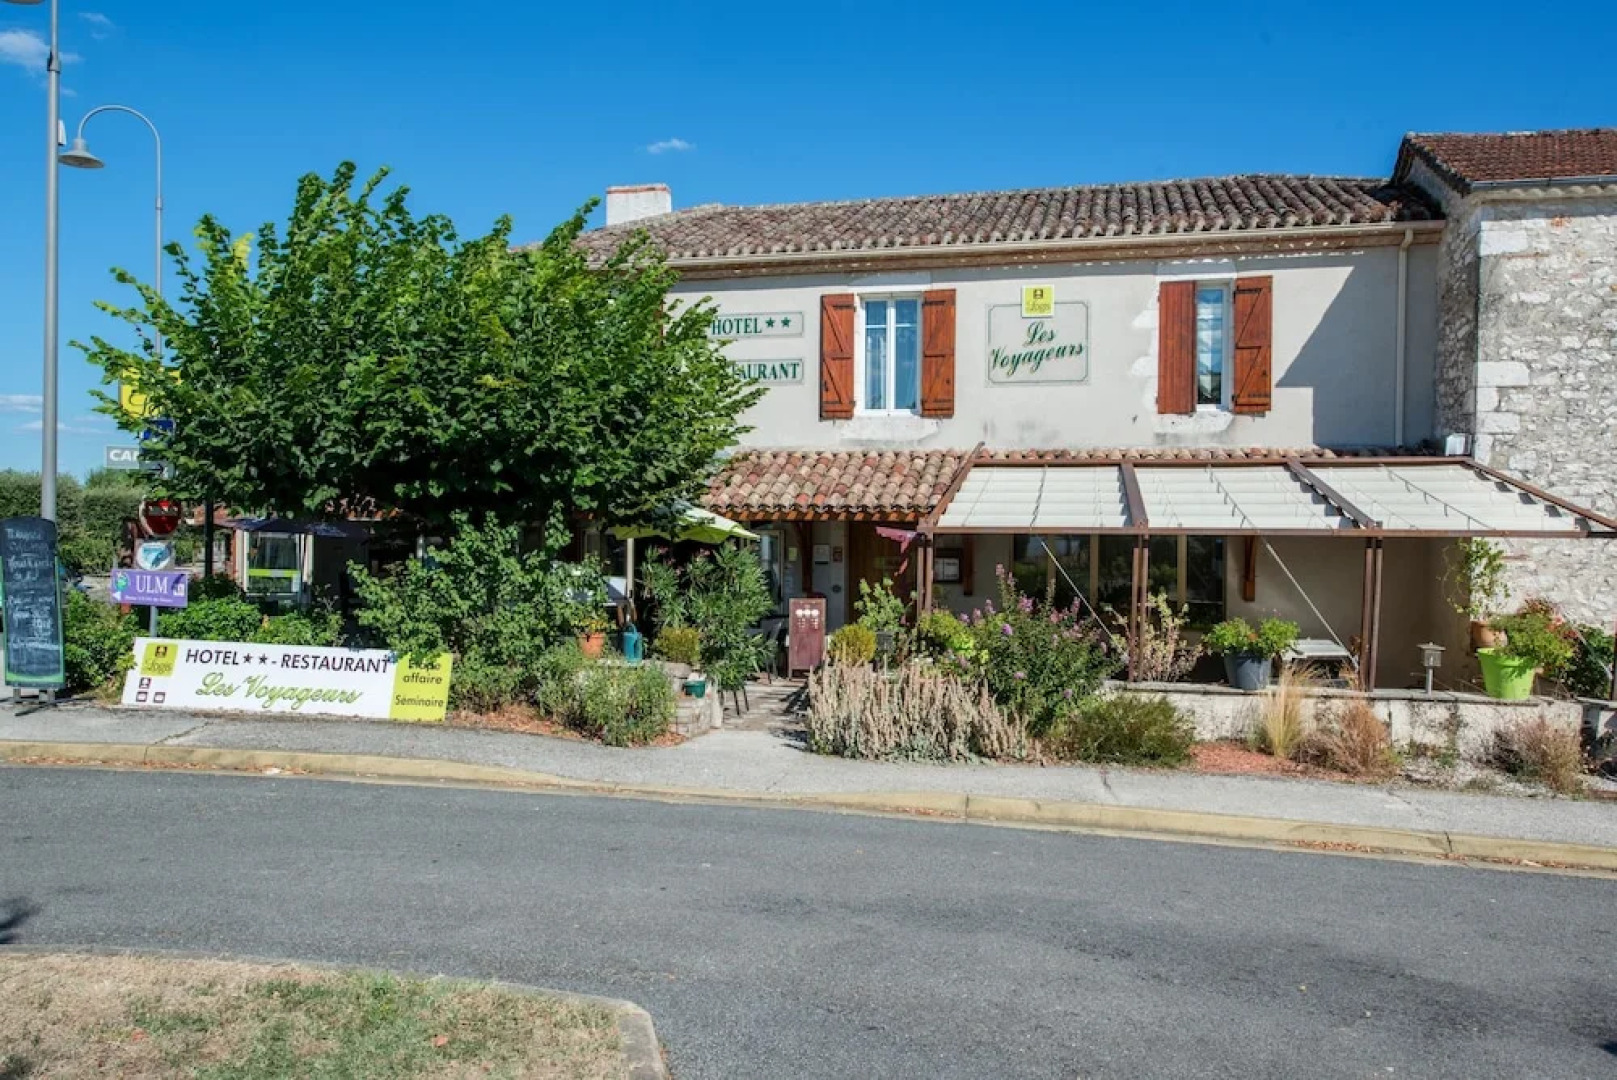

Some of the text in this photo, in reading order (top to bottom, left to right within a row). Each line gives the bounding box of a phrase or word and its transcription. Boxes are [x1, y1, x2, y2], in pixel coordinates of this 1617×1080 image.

[711, 317, 762, 335] HOTEL
[1022, 320, 1055, 348] Les
[991, 343, 1083, 377] Voyageurs
[136, 575, 168, 594] ULM
[185, 648, 240, 666] HOTEL
[280, 653, 391, 674] RESTAURANT
[195, 672, 241, 697] Les
[403, 672, 442, 685] affaire
[243, 674, 363, 710] Voyageurs
